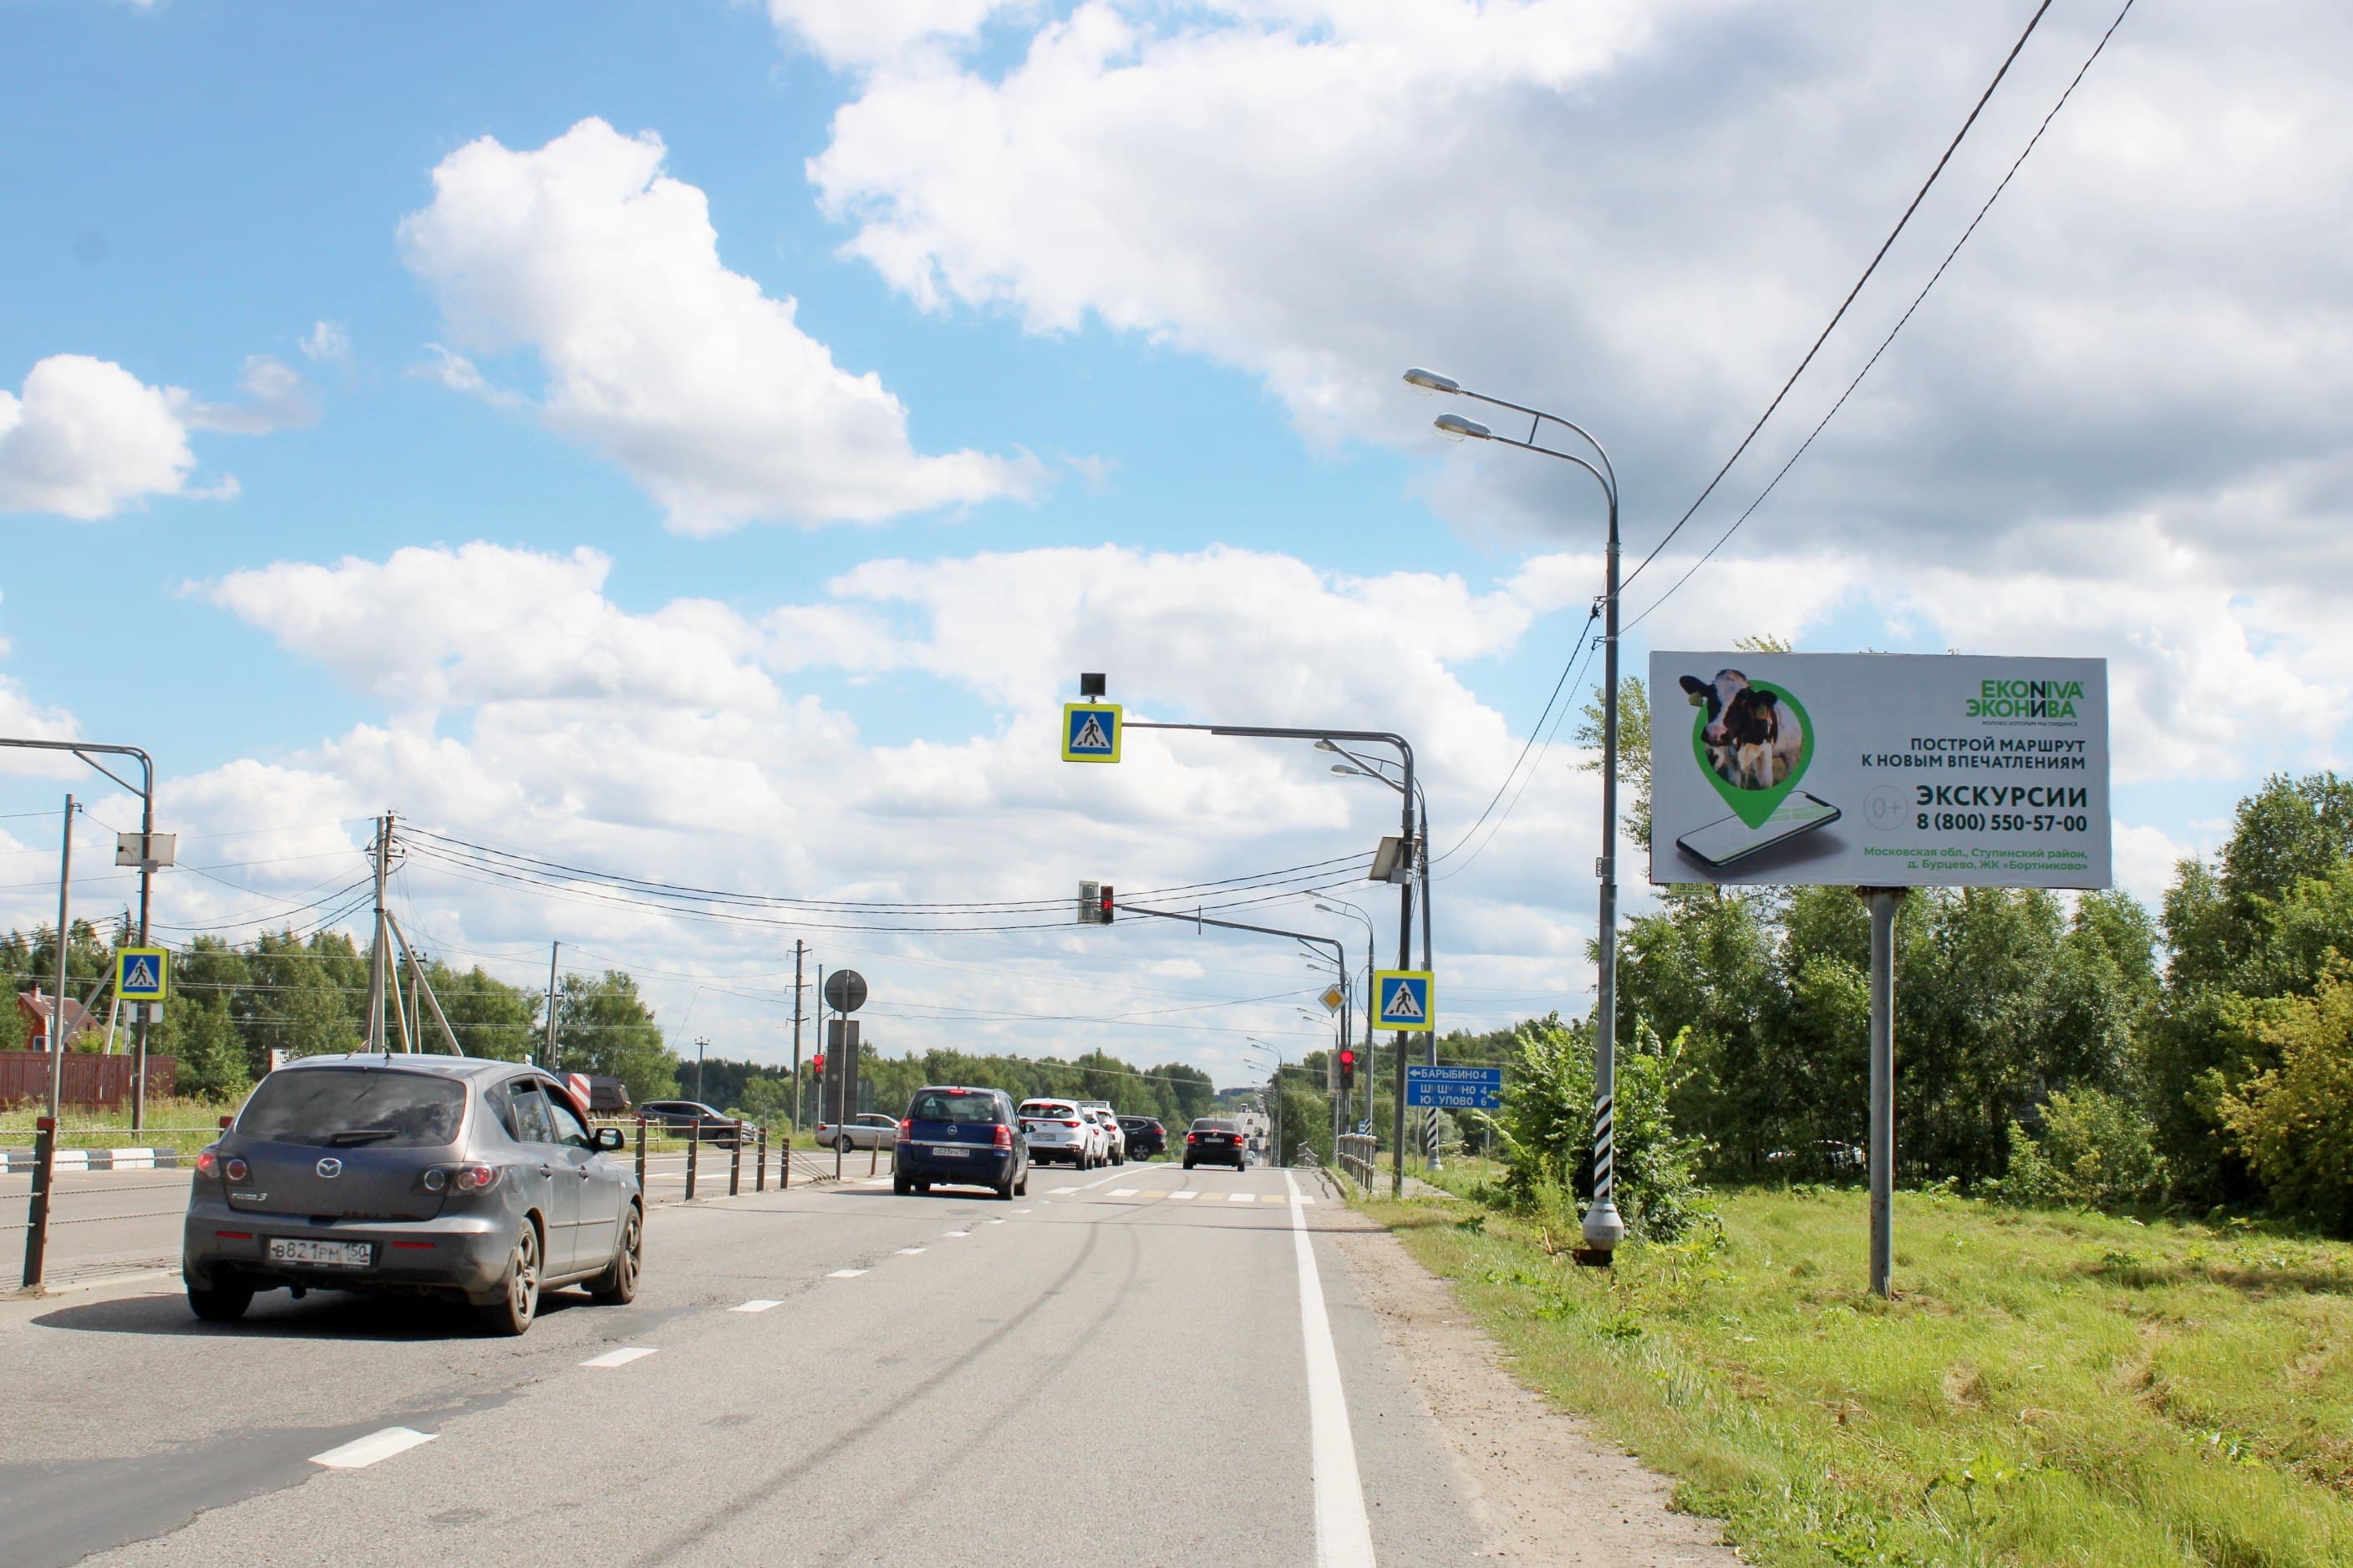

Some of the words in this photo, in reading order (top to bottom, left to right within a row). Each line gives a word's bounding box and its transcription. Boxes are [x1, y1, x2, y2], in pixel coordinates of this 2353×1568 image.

[1981, 680, 2084, 699] EKONIVA
[1965, 699, 2076, 718] ЭКОНИВА
[1912, 736, 1995, 751] ПОСТРОЙ
[2000, 739, 2086, 752] МАРШРУТ
[1863, 754, 1872, 766] К
[1878, 754, 1942, 767] НОВЫМ
[1949, 755, 2085, 769] ВПЕЧАТЛЕНИЯМ
[1917, 785, 2087, 807] ЭКСКУРСИИ
[1873, 798, 1902, 819] 0+
[1918, 814, 1929, 830] 8
[1935, 813, 1985, 831] (800)
[1991, 814, 2087, 831] 550-57-00
[1865, 847, 1937, 856] Московская
[1940, 847, 1968, 858] обл.,
[1971, 847, 2045, 860] Ступинский
[2048, 850, 2087, 860] район,
[1923, 860, 1976, 870] Бурцево,
[1979, 860, 2000, 869] ЖК
[2003, 860, 2088, 871] «Бортниково»
[1421, 1069, 1479, 1079] БАРЫБИНО
[1481, 1071, 1487, 1080] 4
[1420, 1083, 1476, 1094] ШШНО
[1480, 1086, 1487, 1094] 4
[1481, 1097, 1487, 1106] 6
[258, 1192, 268, 1201] 3
[275, 1241, 340, 1261] В821РМ
[344, 1242, 367, 1257] 150
